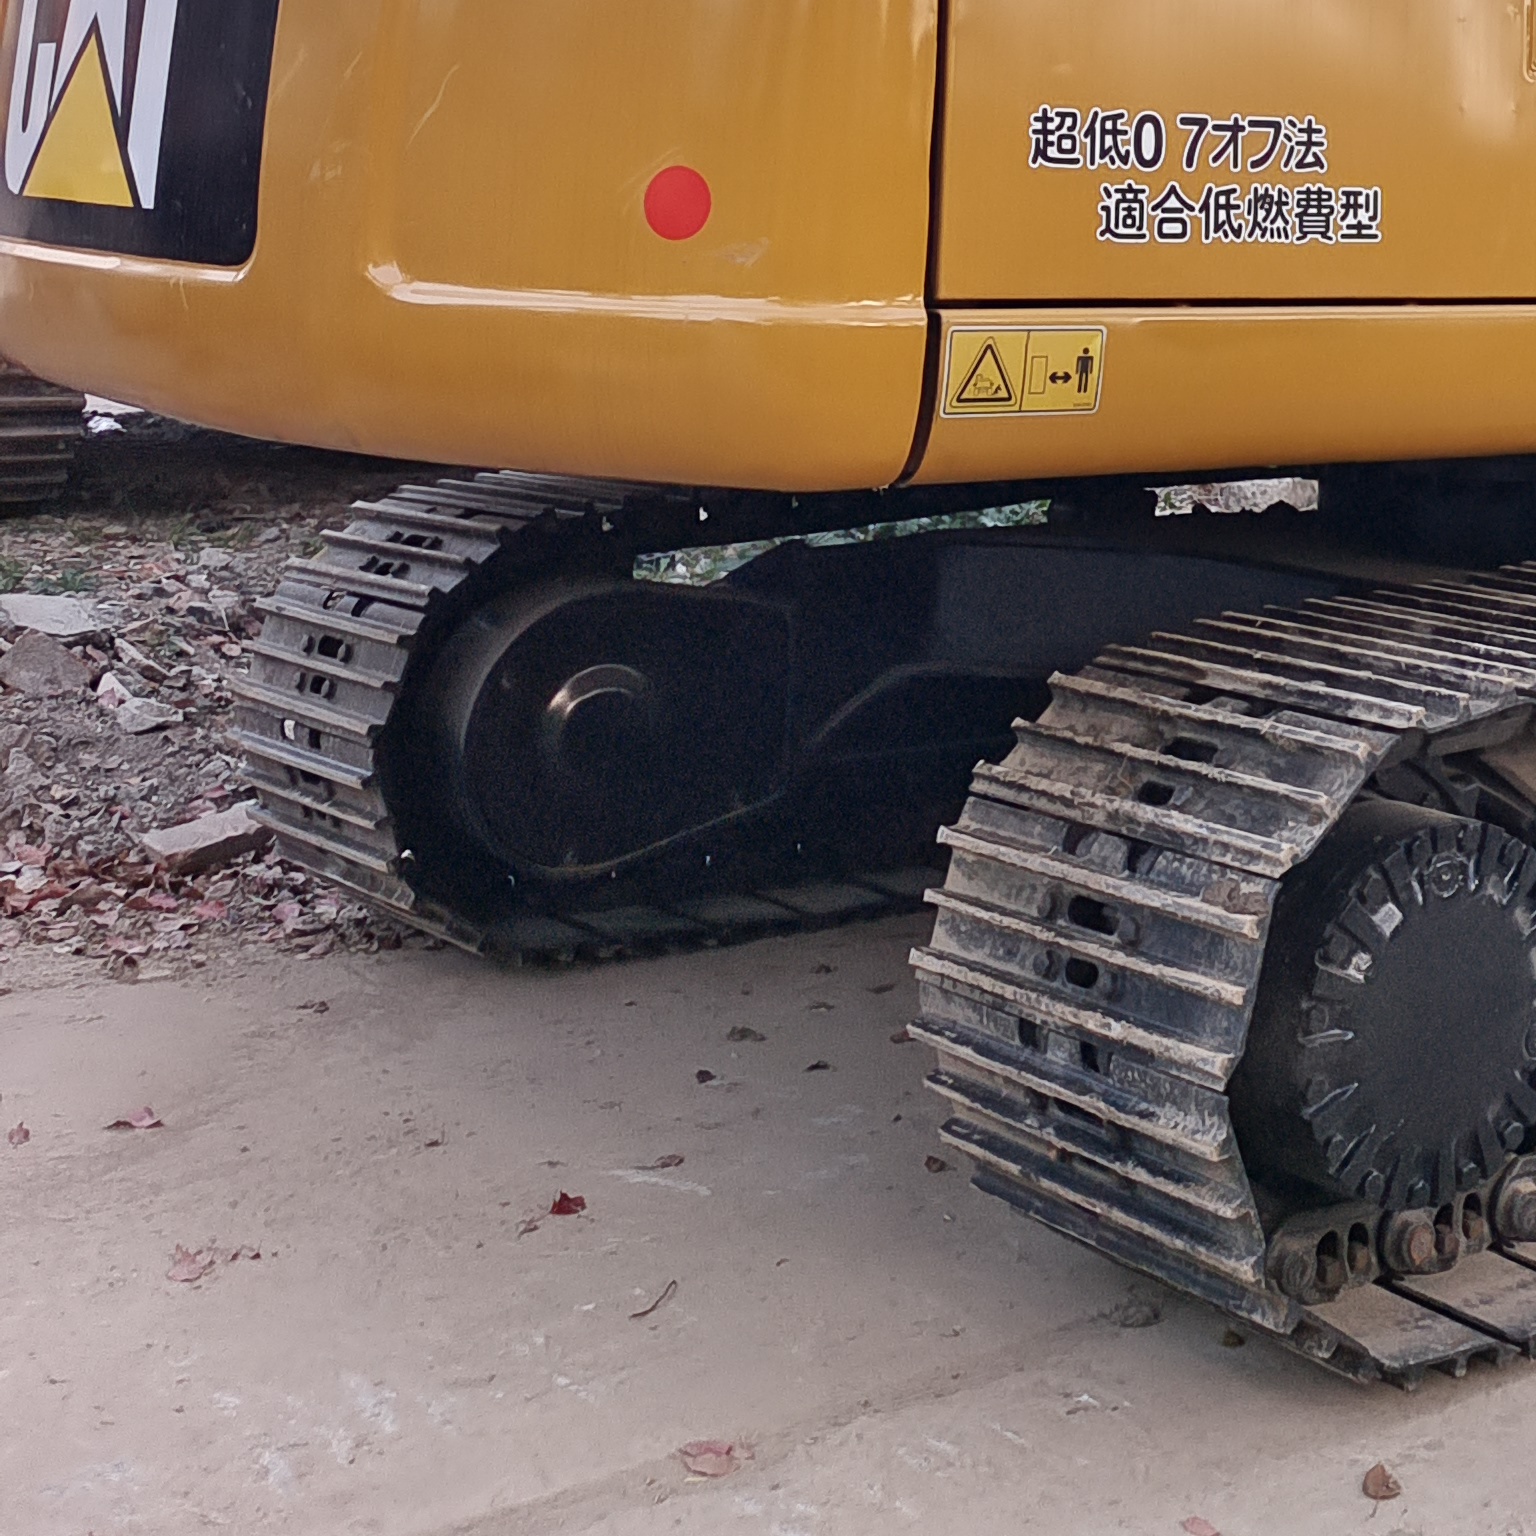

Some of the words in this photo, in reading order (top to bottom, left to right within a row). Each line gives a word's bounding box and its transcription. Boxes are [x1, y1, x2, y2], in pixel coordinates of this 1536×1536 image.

[1096, 179, 1383, 245] 適合低燃費型
